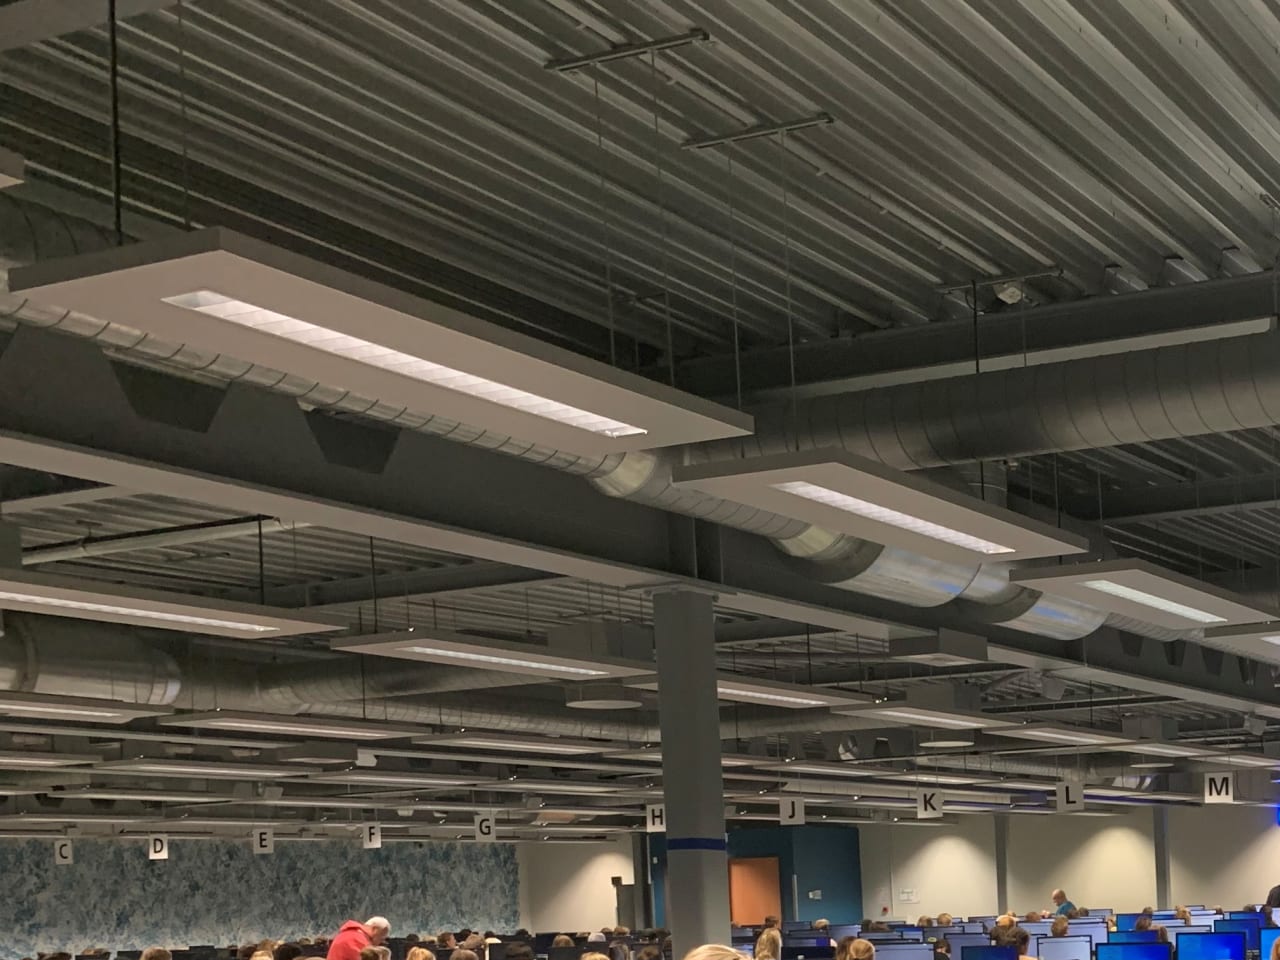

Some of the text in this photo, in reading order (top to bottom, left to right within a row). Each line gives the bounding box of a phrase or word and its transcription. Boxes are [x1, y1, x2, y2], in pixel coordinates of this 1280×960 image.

[1065, 786, 1076, 804] L
[1208, 777, 1229, 796] M
[788, 800, 796, 819] J
[923, 793, 936, 811] K
[651, 808, 663, 826] H
[368, 826, 376, 842] F
[479, 818, 491, 836] G
[153, 838, 164, 854] D
[259, 831, 268, 848] E
[59, 843, 69, 859] C
